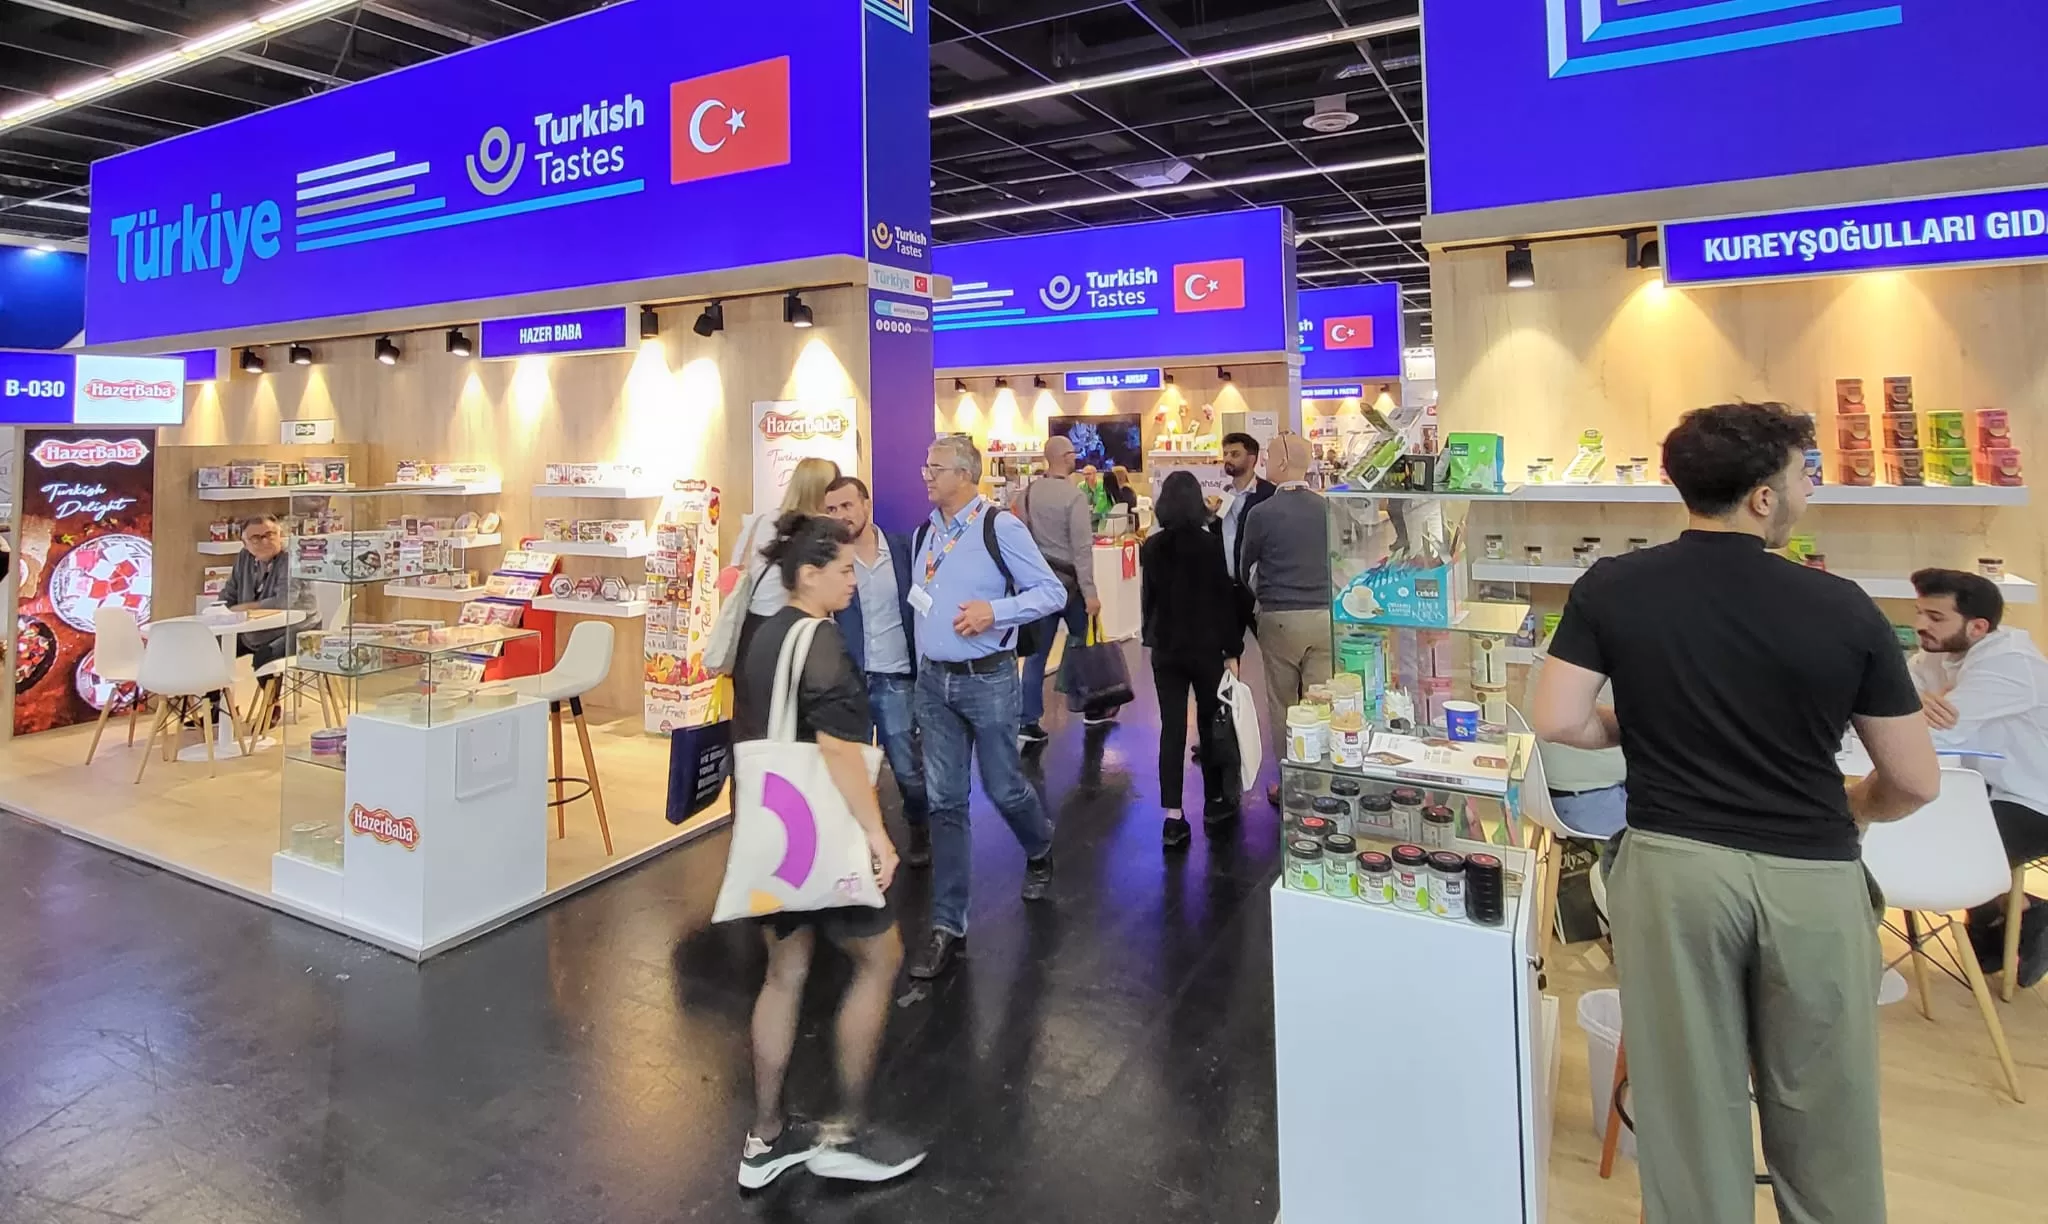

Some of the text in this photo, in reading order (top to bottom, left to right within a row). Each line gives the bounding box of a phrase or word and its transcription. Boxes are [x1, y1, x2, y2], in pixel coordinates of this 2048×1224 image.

[534, 93, 645, 146] Turkish
[535, 144, 625, 186] Tastes
[110, 192, 282, 285] Türkiye
[894, 226, 927, 246] Turkish
[1704, 209, 2048, 261] KUREYŞOĞULLARI GID
[895, 241, 922, 258] Tastes
[873, 269, 910, 290] Türkiye
[1086, 267, 1158, 287] Turkish
[1087, 289, 1146, 308] Tastes
[519, 323, 582, 344] HAZER BABA
[5, 379, 65, 398] B-030
[91, 382, 171, 399] HazerBaba
[766, 416, 842, 433] HazerBaba
[46, 445, 137, 461] HazerBaba
[41, 483, 107, 503] Turkish
[55, 498, 136, 521] Delight
[354, 808, 413, 842] HazerBaba
